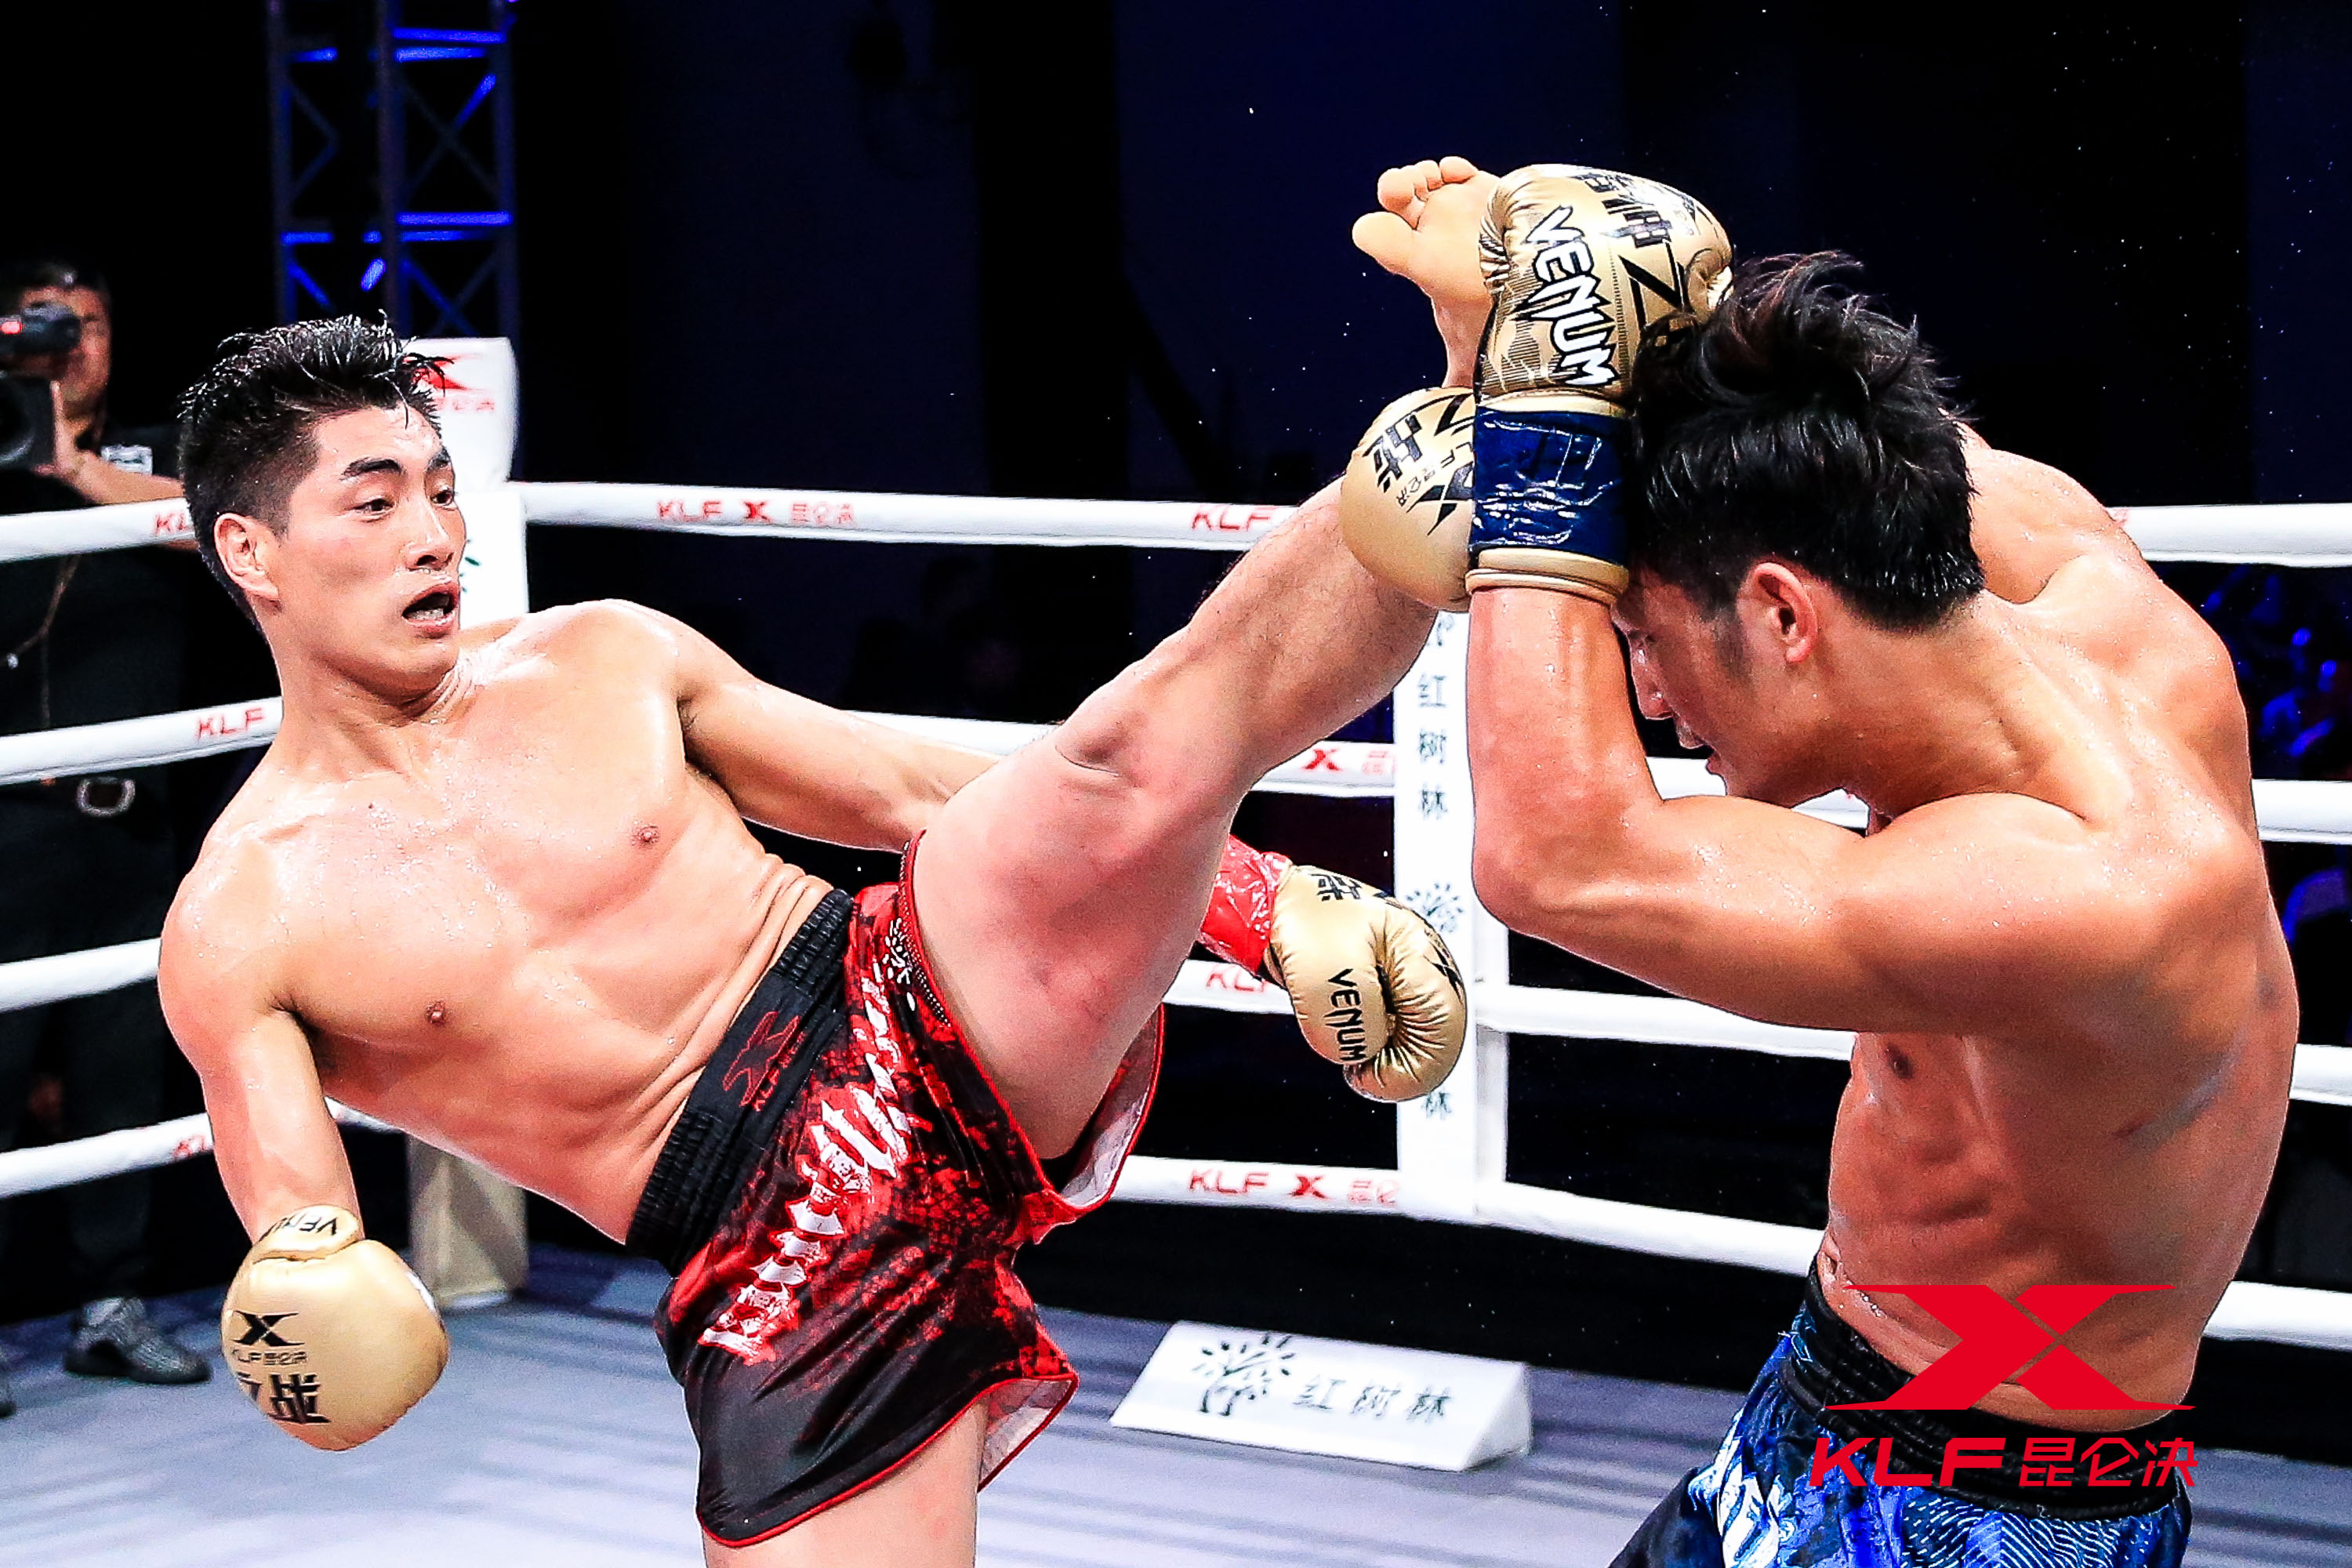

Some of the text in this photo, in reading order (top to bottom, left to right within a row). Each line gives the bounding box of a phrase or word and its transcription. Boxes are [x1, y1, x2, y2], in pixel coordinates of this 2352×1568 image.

[1509, 205, 1618, 387] VENUM
[153, 510, 194, 535] KL
[657, 499, 722, 523] KLF
[1190, 503, 1277, 532] KLF
[195, 706, 265, 741] KLF
[1324, 967, 1367, 1062] VENUM
[172, 1134, 213, 1158] KL
[1189, 1169, 1270, 1196] KLF
